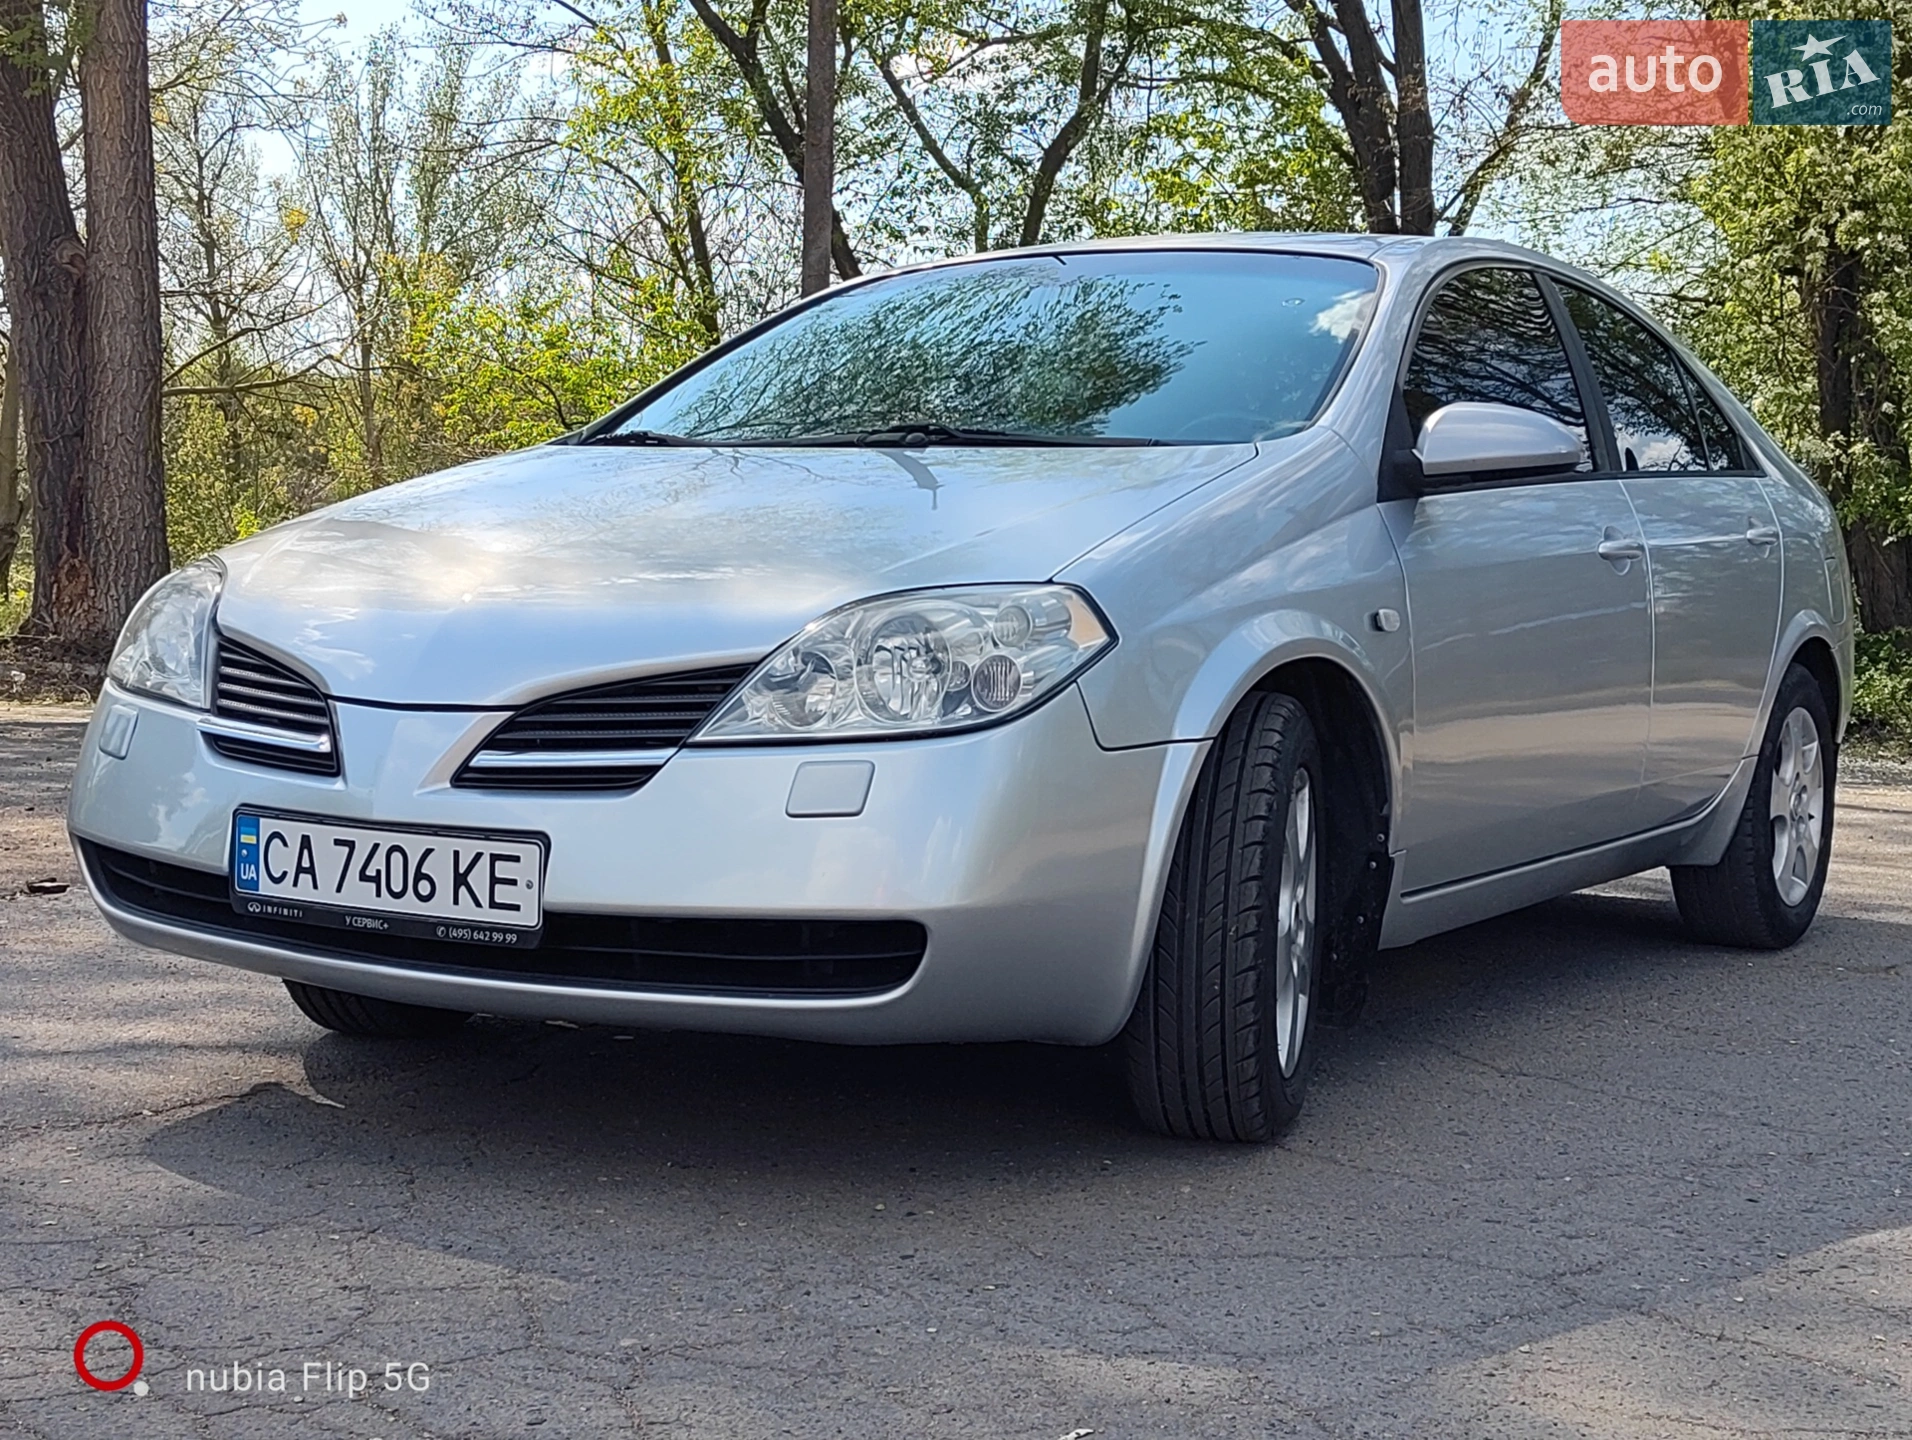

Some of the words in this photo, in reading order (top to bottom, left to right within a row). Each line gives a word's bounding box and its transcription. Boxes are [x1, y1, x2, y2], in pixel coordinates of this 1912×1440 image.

[240, 862, 257, 881] UA
[263, 830, 319, 891] CA
[333, 838, 437, 903] 7406
[452, 849, 522, 912] KE
[262, 905, 303, 918] INFINITI
[448, 925, 472, 941] (495)
[473, 930, 490, 941] 642
[491, 931, 504, 944] 99
[505, 932, 518, 944] 99
